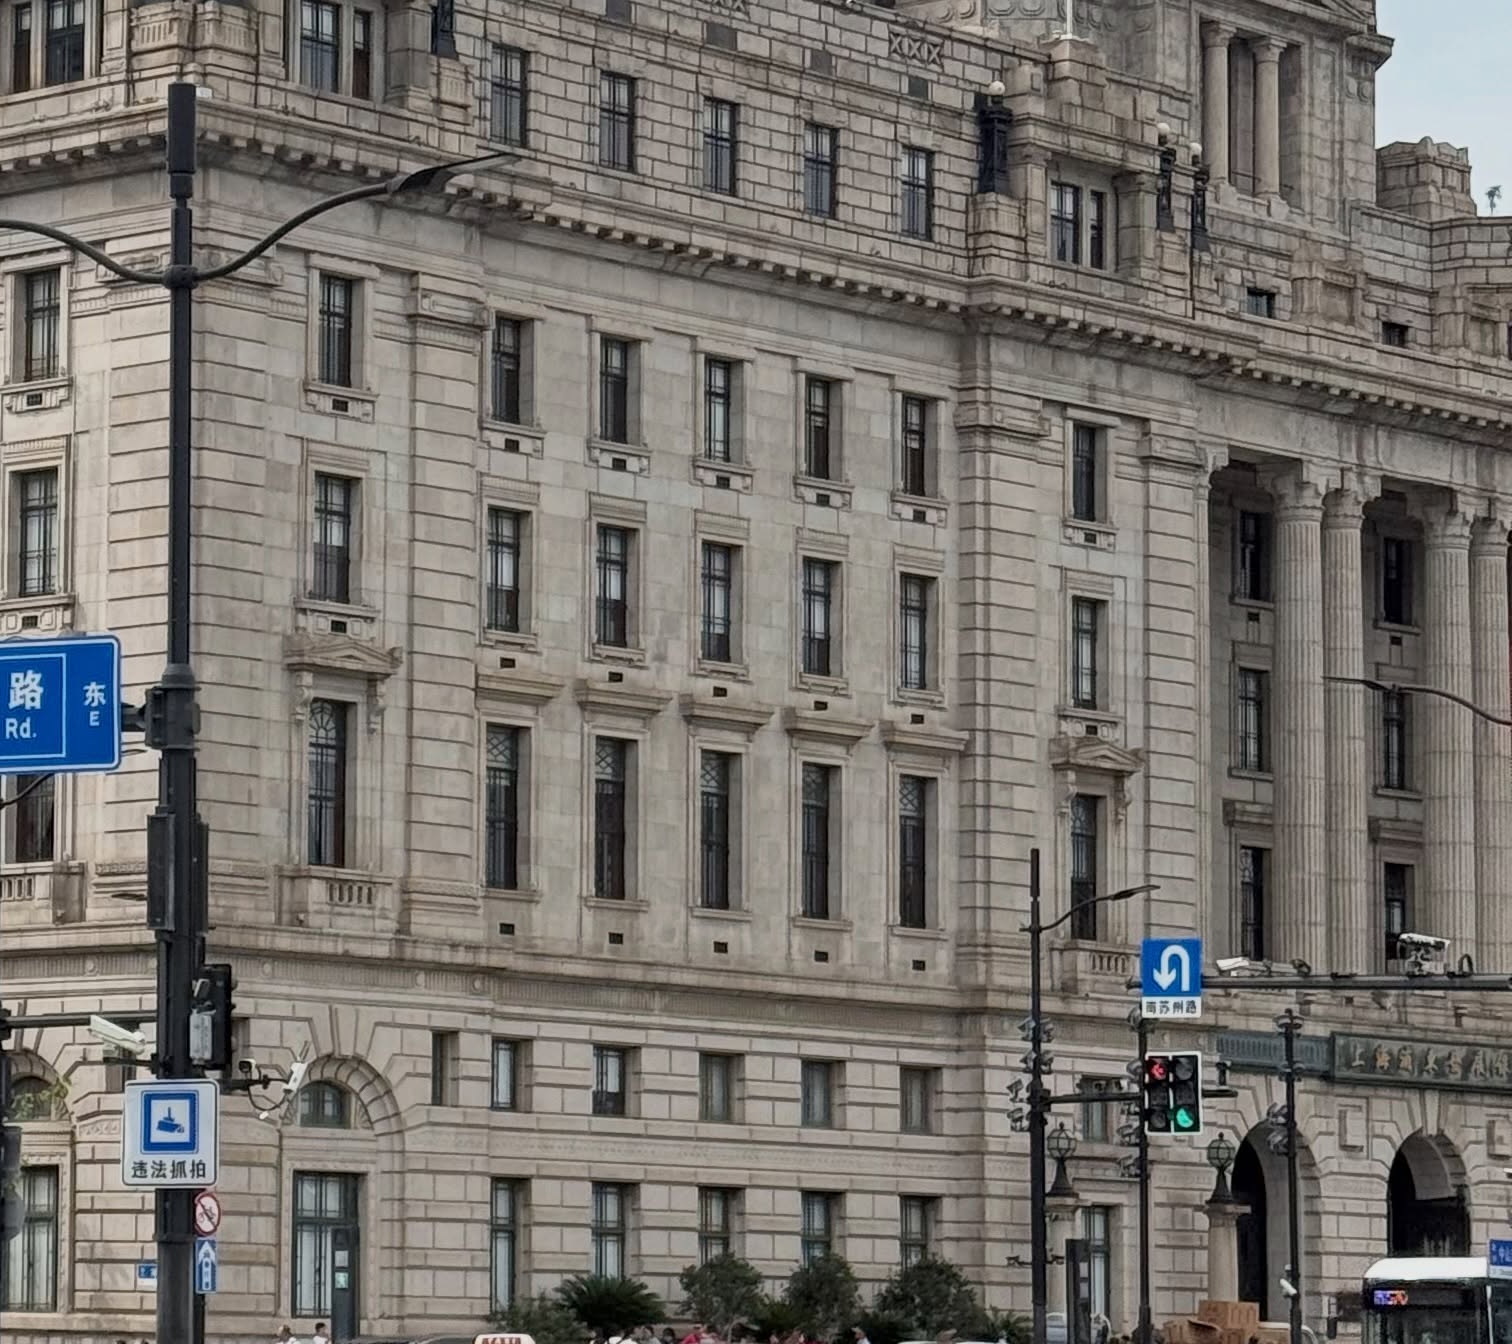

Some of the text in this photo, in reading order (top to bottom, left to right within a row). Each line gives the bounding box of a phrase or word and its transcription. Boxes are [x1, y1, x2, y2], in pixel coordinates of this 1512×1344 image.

[83, 682, 106, 706] 东
[4, 716, 38, 740] Rd.
[89, 711, 100, 727] E
[1145, 999, 1197, 1015] 南苏州路
[131, 1159, 207, 1180] 违法抓拍
